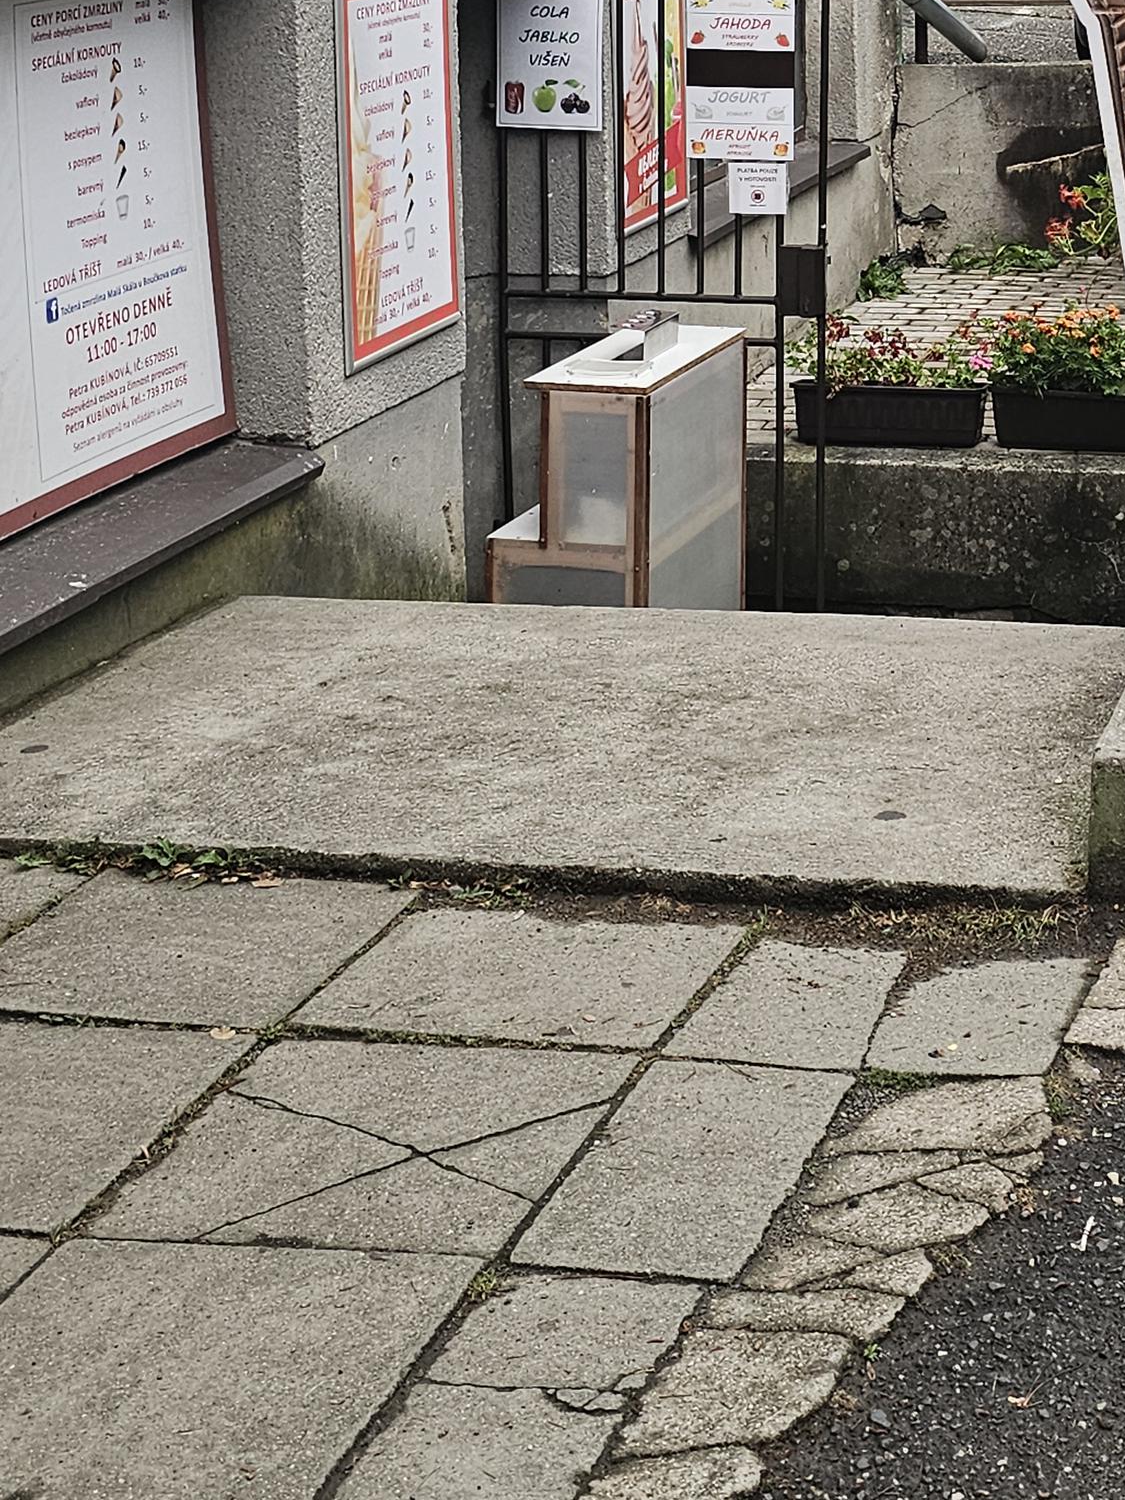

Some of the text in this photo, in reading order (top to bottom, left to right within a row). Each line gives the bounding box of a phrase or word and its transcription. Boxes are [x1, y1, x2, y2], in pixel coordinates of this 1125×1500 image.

[30, 11, 56, 28] CENY
[55, 4, 82, 24] PORCÍ
[83, 0, 124, 19] ZMRZLINY
[356, 4, 375, 20] CENY
[530, 5, 569, 19] COLA
[709, 16, 772, 30] JAHODA
[518, 28, 580, 44] JABLKO
[31, 41, 122, 72] SPECIÁLNÍ KORNOUTY
[529, 50, 571, 67] VIŠEŇ
[359, 64, 431, 95] SPECIÁLNÍ KORNOUTY
[707, 90, 771, 104] JOGURT
[700, 126, 780, 142] MERUŇKA
[43, 268, 77, 294] LEDOVÁ
[79, 260, 103, 281] TŘÍŠŤ
[381, 276, 423, 308] LEDOVÁ TŘÍŠŤ
[65, 286, 173, 345] OTEVŘENO DENNĚ
[87, 336, 118, 363] 11:00
[127, 321, 157, 347] 17:00
[68, 383, 88, 400] Petra
[89, 362, 132, 390] KUBÍNOVÁ,
[64, 419, 85, 436] Petra
[86, 397, 129, 426] KUBÍNOVÁ,
[146, 385, 160, 400] 739
[161, 380, 173, 393] 372
